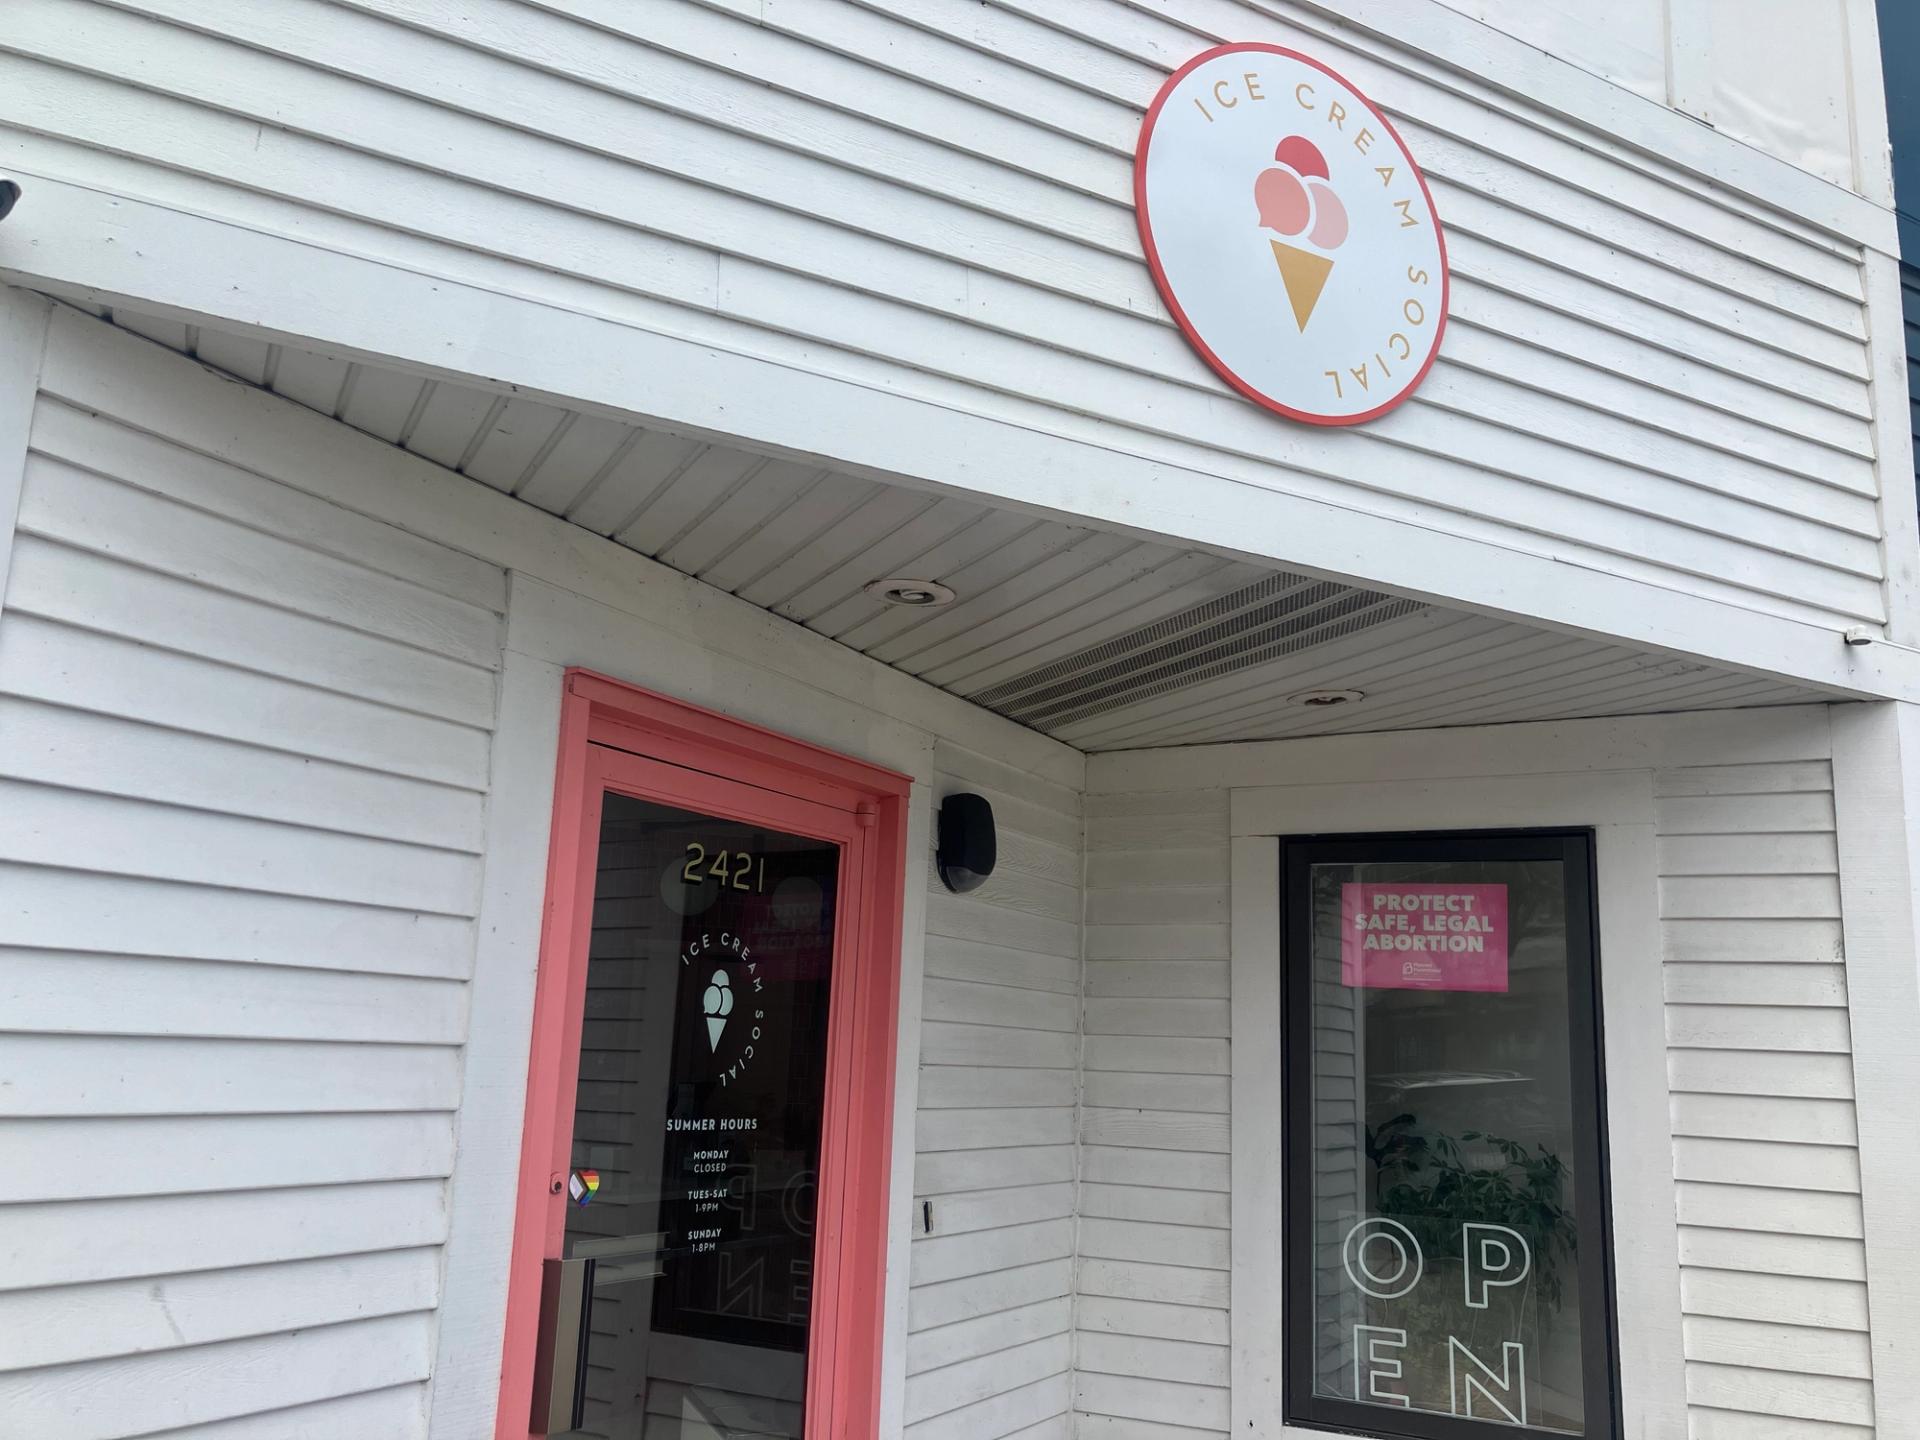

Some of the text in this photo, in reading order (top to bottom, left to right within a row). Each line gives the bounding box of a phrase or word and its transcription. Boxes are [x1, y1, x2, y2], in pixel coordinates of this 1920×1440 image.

[1194, 73, 1428, 398] ICE CREAM SOCIAL
[684, 842, 764, 892] 2421
[1373, 894, 1474, 912] PROTECT
[1355, 913, 1494, 933] SAFE, LEGAL
[1363, 933, 1484, 952] ABORTION
[681, 932, 763, 1087] ICE CREAM SOCIAL
[666, 1118, 758, 1131] SUMMER HOURS
[693, 1150, 729, 1160] MONDAY
[694, 1163, 727, 1173] CLOSED
[688, 1188, 728, 1200] TUES-SAT
[688, 1228, 722, 1240] SUNDAY
